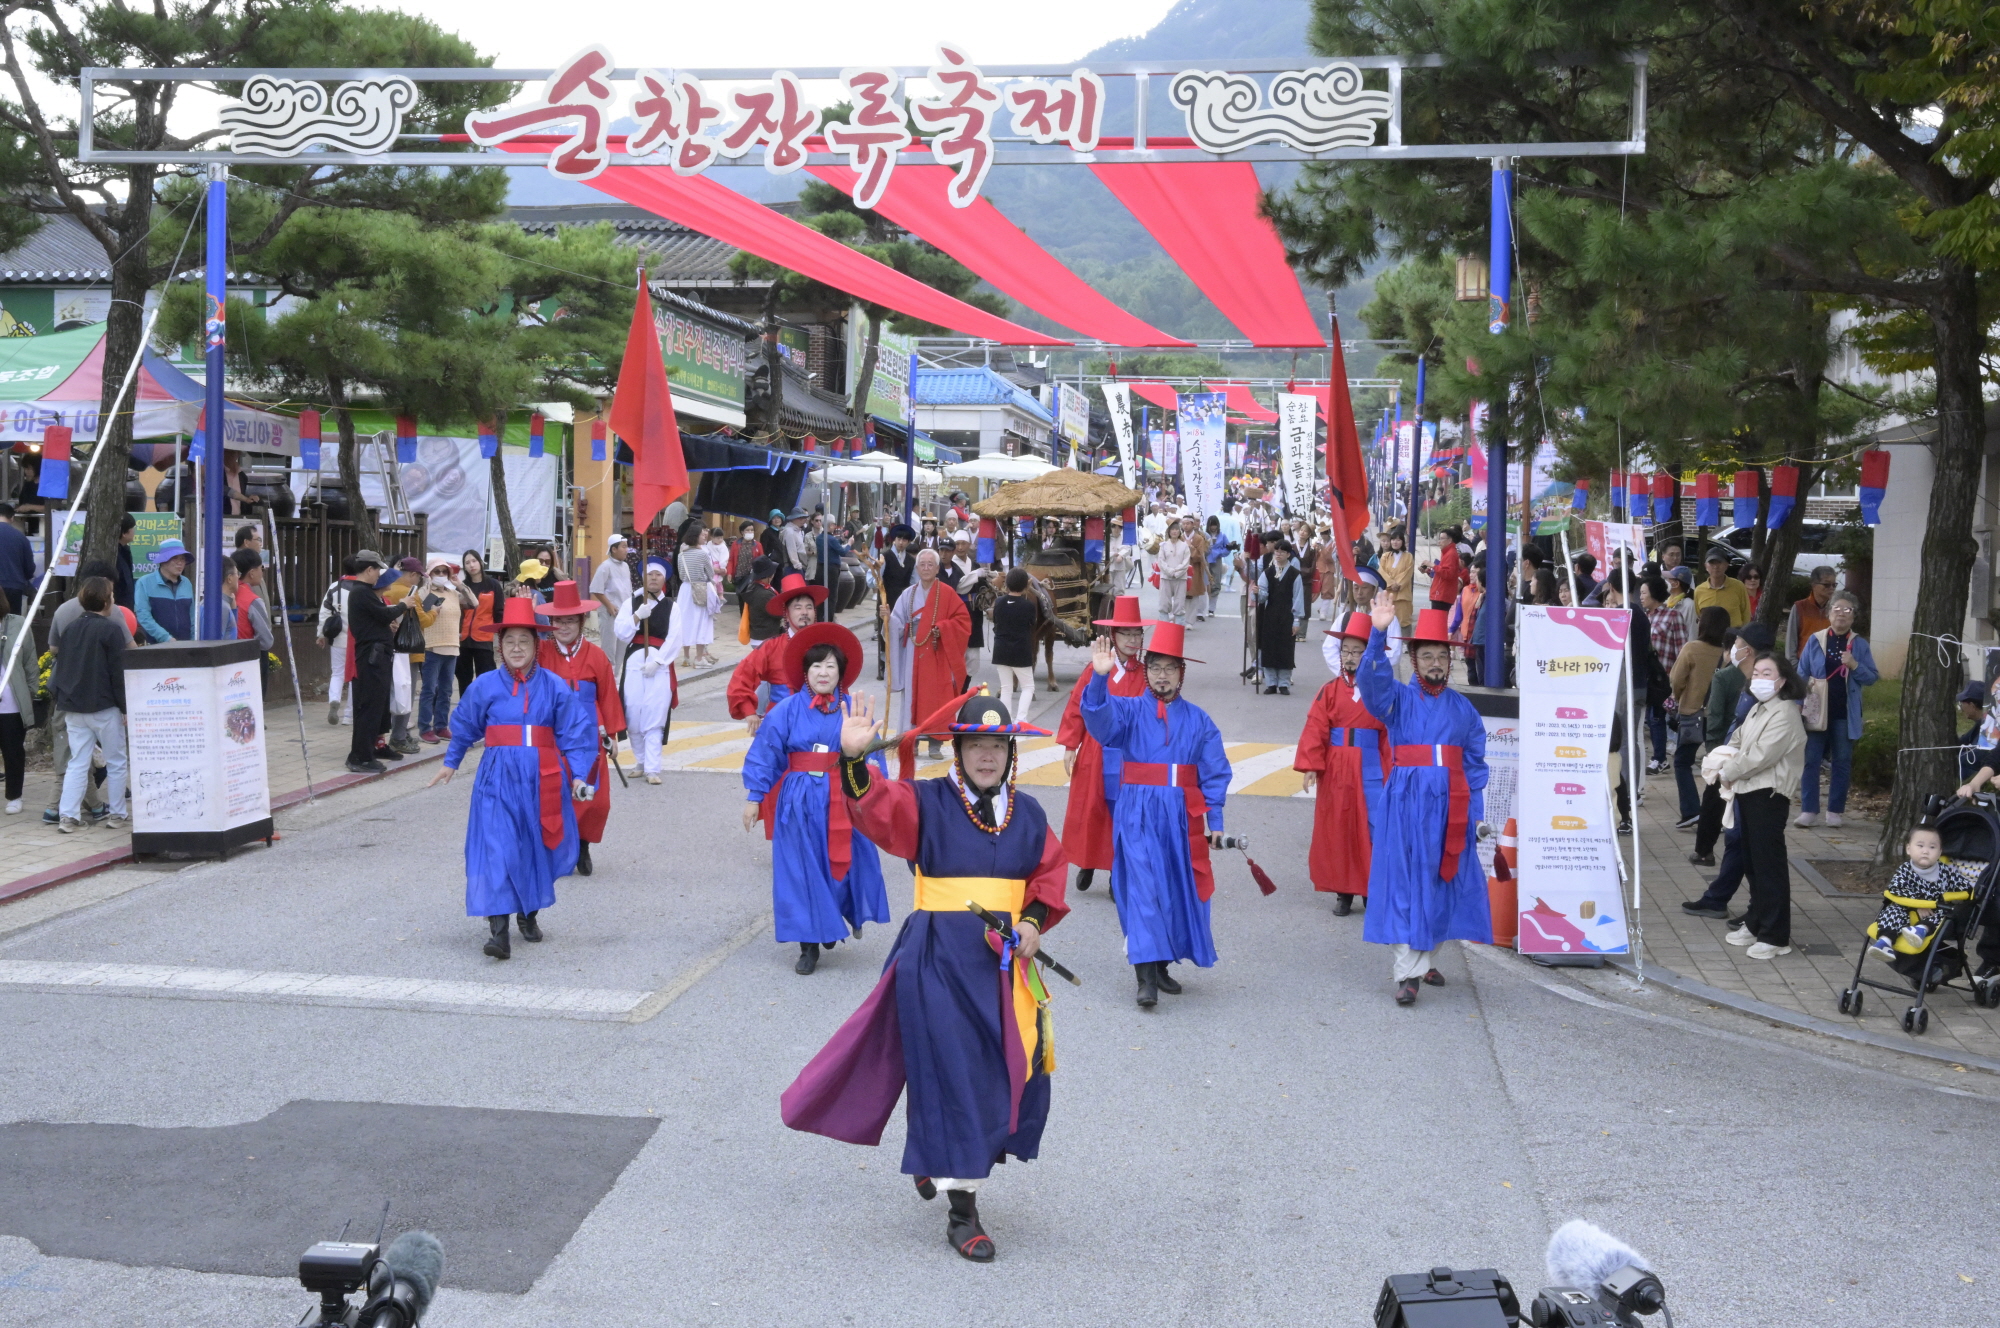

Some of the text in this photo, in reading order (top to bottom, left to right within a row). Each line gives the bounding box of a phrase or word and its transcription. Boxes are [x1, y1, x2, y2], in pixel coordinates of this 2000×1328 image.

[467, 43, 1102, 204] 순창장류축제
[1536, 659, 1610, 674] 발효나라 1997
